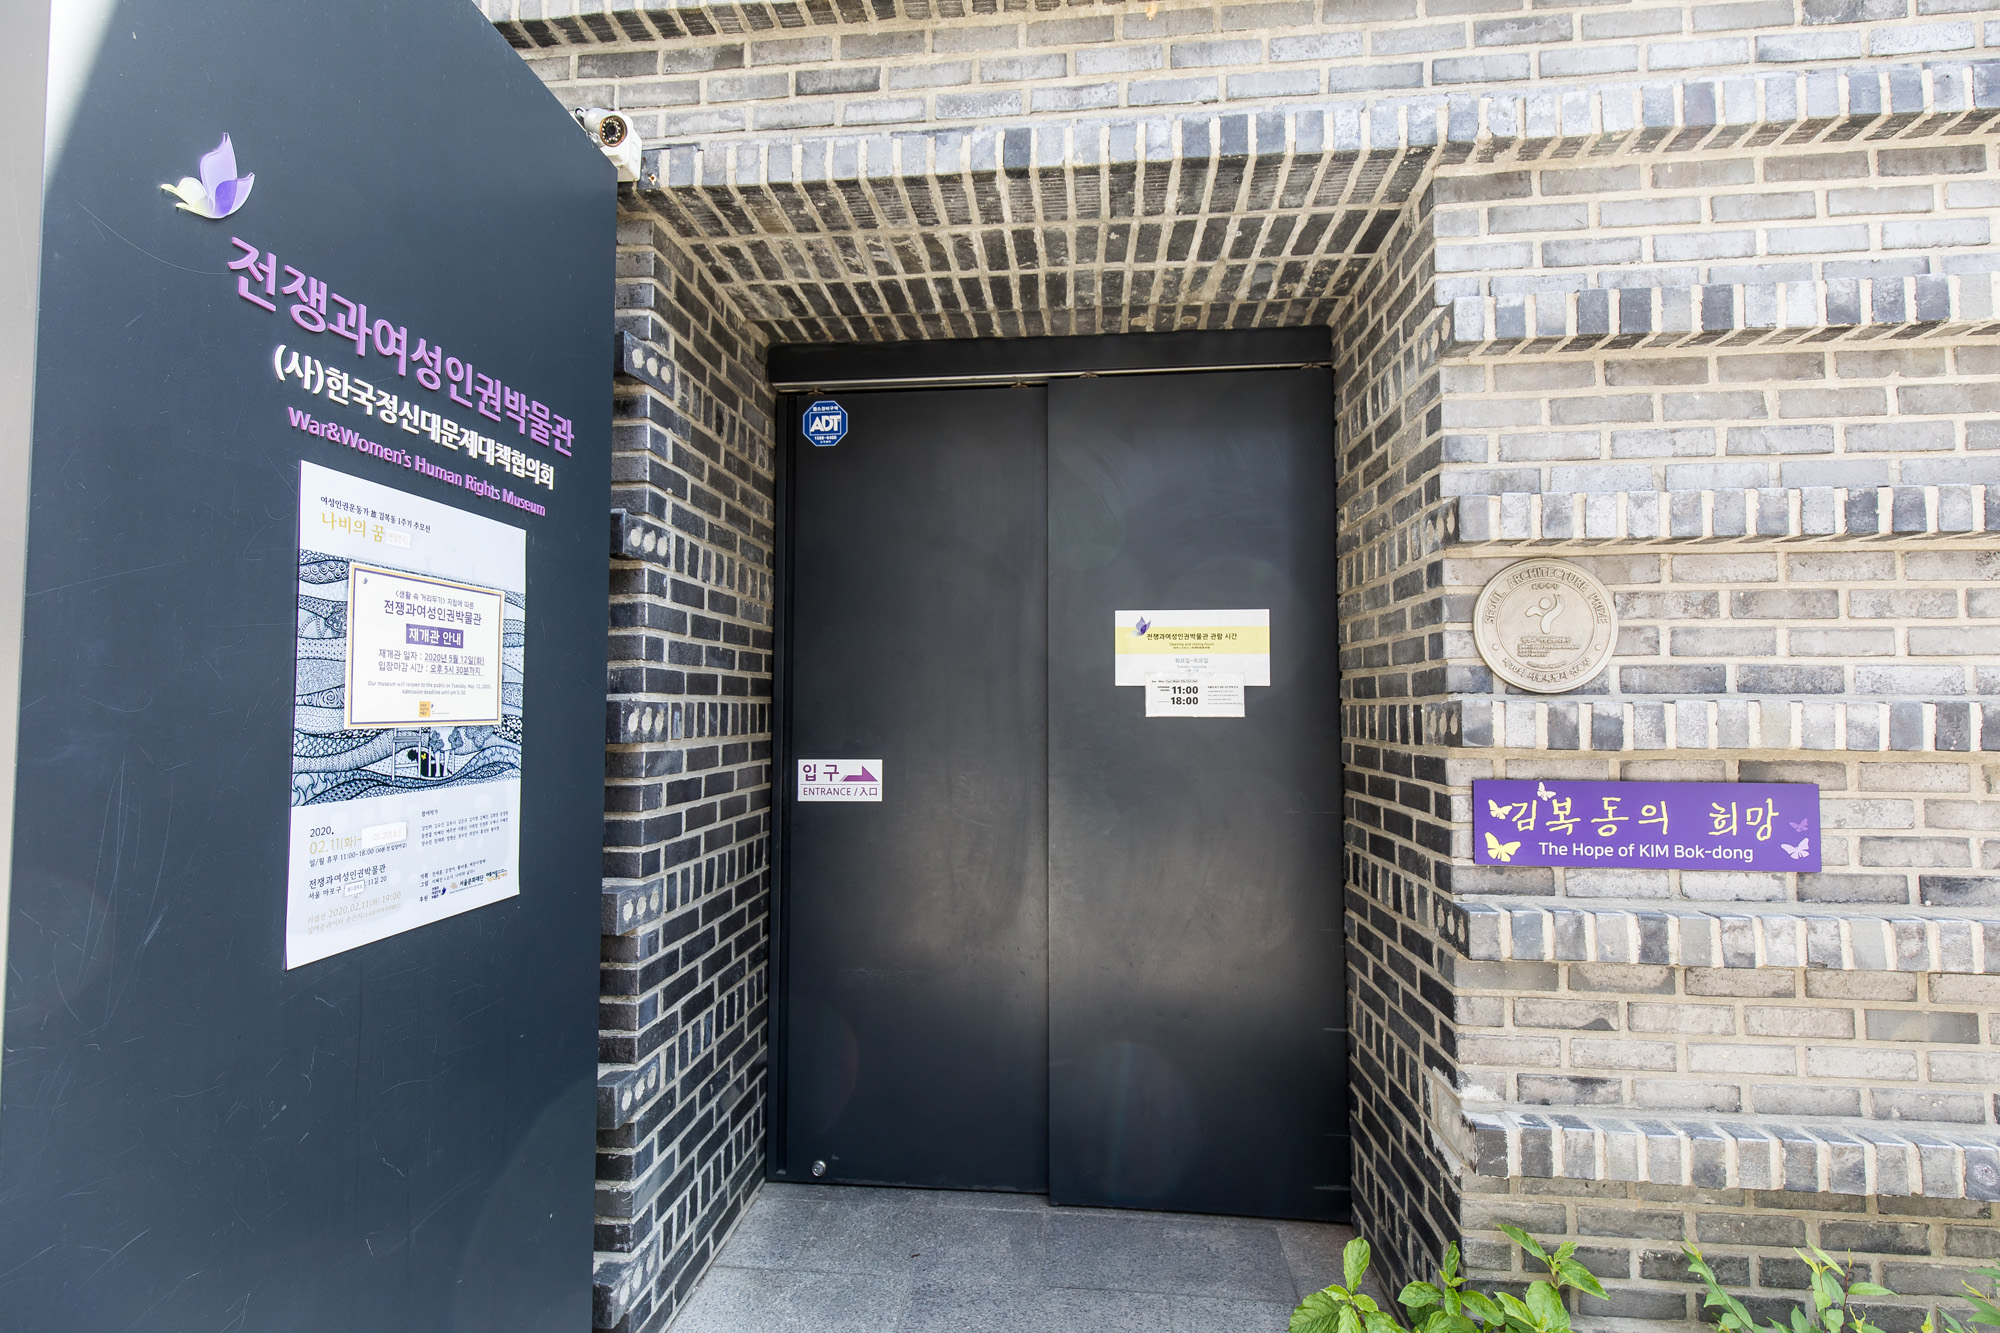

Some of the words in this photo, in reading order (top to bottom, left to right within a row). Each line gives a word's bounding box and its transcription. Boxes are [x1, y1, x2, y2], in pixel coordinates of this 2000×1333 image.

[227, 236, 575, 457] 전쟁과여성인권박물관
[274, 344, 554, 490] (사)한국정신대문제대책협의회
[810, 415, 841, 432] ADT
[414, 456, 462, 486] Human
[465, 474, 500, 500] Rights
[502, 488, 546, 516] Museum
[320, 496, 369, 516] 여성인권운동가
[379, 512, 397, 524] 김복동
[398, 518, 412, 528] 1주기
[414, 522, 431, 534] 추모전
[321, 512, 366, 538] 나비의
[372, 525, 384, 543] 꿈
[1485, 591, 1506, 625] SEOUL
[1507, 567, 1590, 592] ARCHITECTURE
[1588, 592, 1608, 624] PRIZE
[384, 600, 482, 626] 전쟁과여성인권박물관
[408, 627, 440, 644] 재개관
[443, 631, 461, 646] 안내
[1146, 633, 1208, 641] 전쟁과여성인권박물관
[1210, 633, 1223, 641] 관람
[378, 649, 401, 659] 재개관
[403, 651, 418, 660] 일자
[424, 653, 447, 663] 2020년
[448, 654, 458, 664] 5월
[378, 661, 407, 672] 입장마감
[410, 663, 424, 673] 시간
[430, 665, 442, 674] 오후
[444, 666, 454, 675] 5시
[456, 667, 481, 676] 30분까지
[1172, 686, 1198, 694] 11:00
[1171, 697, 1198, 705] 18:00
[803, 764, 839, 781] 입구
[803, 788, 851, 796] ENTRANCE
[1708, 797, 1779, 841] 희망
[310, 826, 334, 838] 2020.
[327, 855, 338, 864] 휴무
[1538, 842, 1570, 856] The
[1572, 842, 1614, 860] Hope
[1618, 842, 1635, 858] of
[1640, 844, 1669, 858] KIM
[1674, 844, 1754, 863] Bok-dong
[309, 864, 386, 890] 전쟁과여성인권박물관
[308, 891, 320, 900] 서울
[322, 886, 342, 896] 마포구
[368, 877, 379, 886] 11길
[382, 891, 401, 903] 19:00
